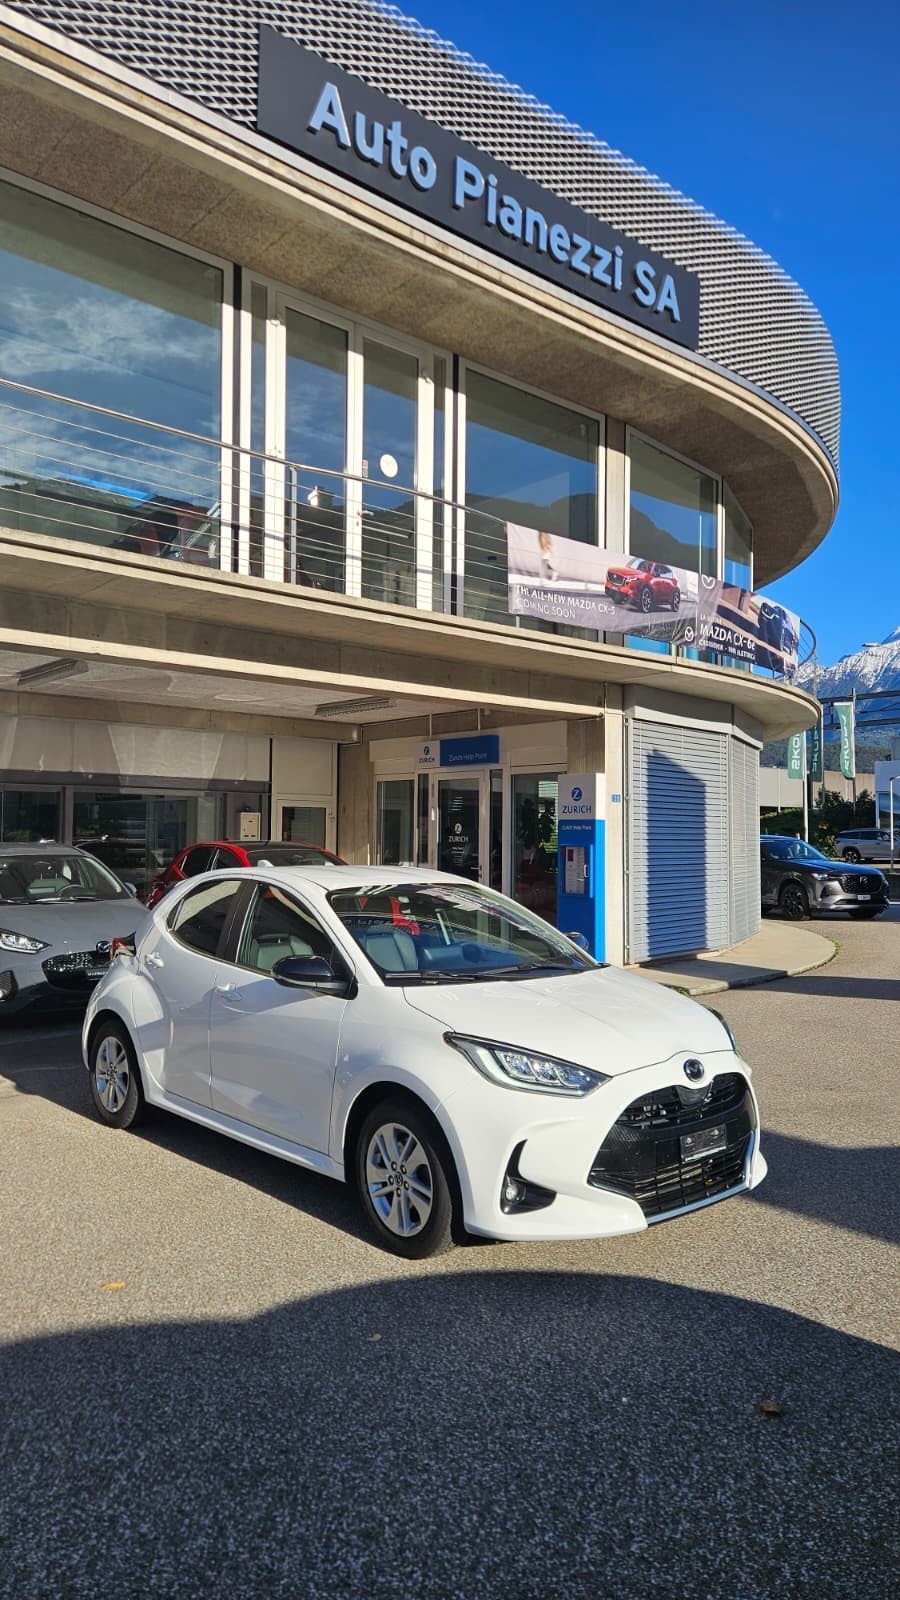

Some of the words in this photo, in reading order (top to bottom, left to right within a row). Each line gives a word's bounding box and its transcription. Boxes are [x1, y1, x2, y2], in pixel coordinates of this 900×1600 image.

[307, 82, 438, 192] Auto
[452, 156, 623, 292] Pianezzi
[631, 260, 681, 323] SA
[531, 590, 566, 604] ALL-NEW
[567, 597, 596, 611] MAZDA
[551, 607, 576, 619] SOON
[700, 623, 732, 643] MAZDA
[562, 805, 592, 814] ZURICH
